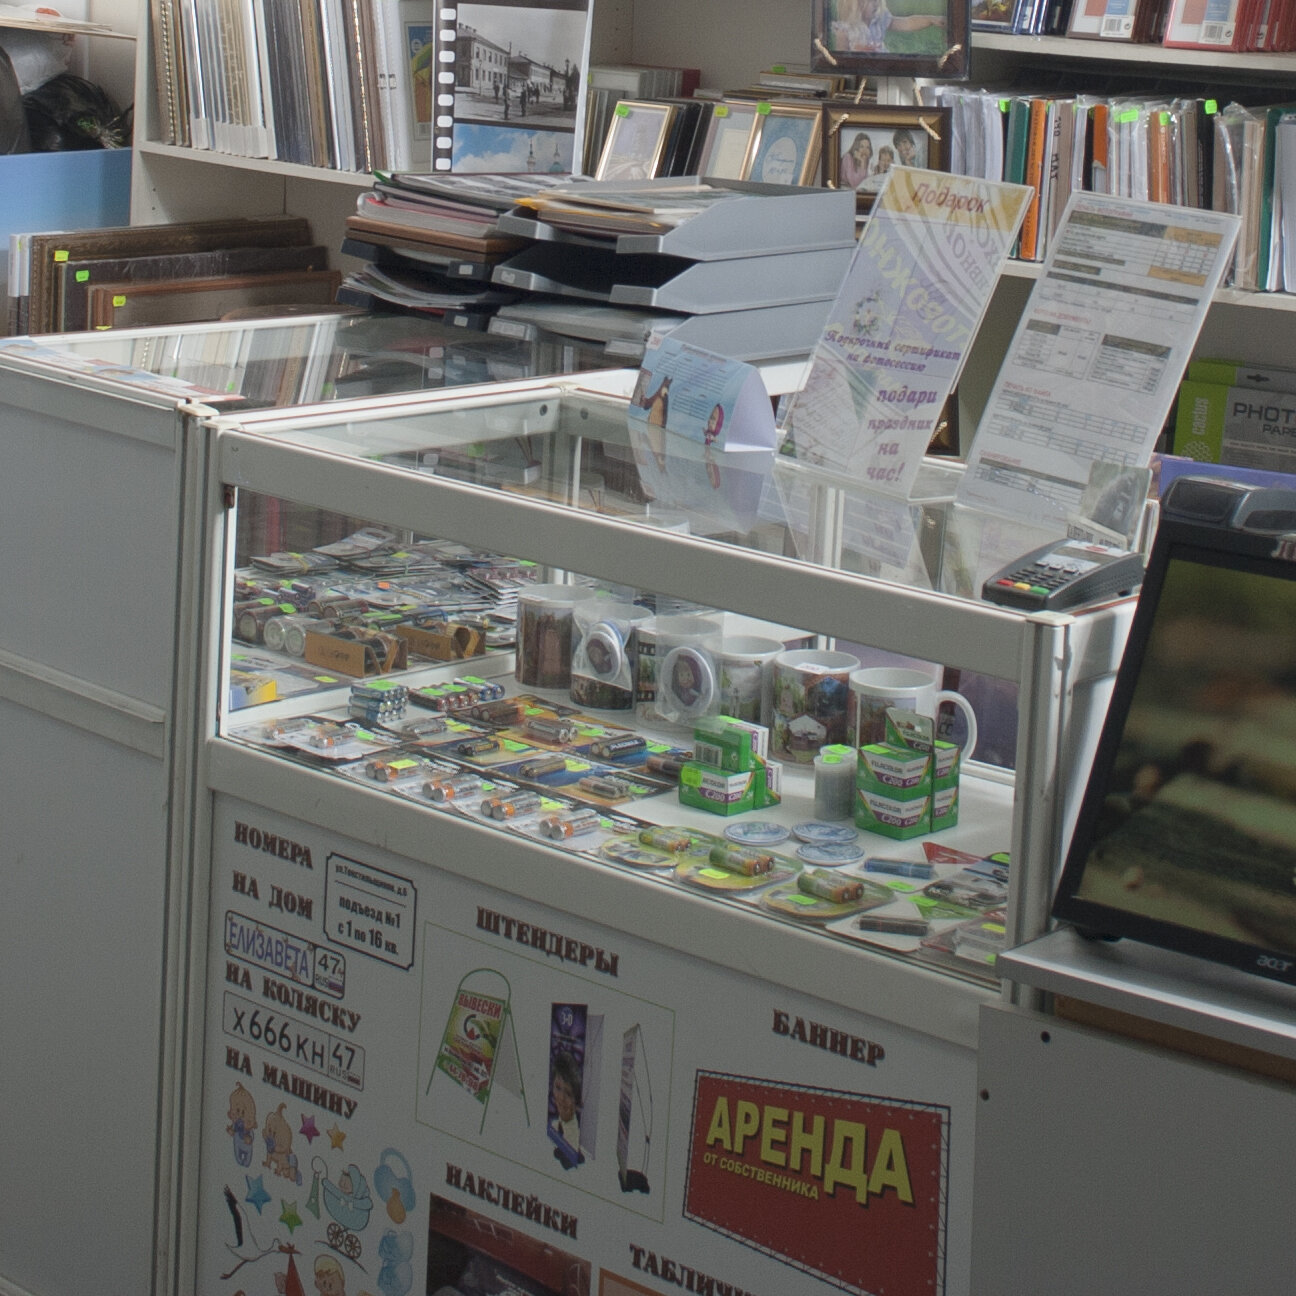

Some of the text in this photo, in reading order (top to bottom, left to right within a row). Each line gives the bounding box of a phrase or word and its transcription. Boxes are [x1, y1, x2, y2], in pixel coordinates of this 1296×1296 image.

[912, 182, 991, 214] Подарок
[824, 329, 961, 362] Подарочный сертификат
[846, 352, 927, 373] на фотосессию
[877, 385, 937, 409] подари
[868, 415, 933, 434] праздник
[1192, 397, 1209, 436] cactus
[877, 441, 900, 456] на
[866, 461, 905, 484] час!
[704, 789, 725, 802] C200
[882, 774, 903, 787] C200
[881, 813, 902, 826] C200
[234, 820, 313, 870] НОМЕРА
[232, 870, 313, 920] НА ДОМ
[339, 896, 401, 929] подъезд №1
[229, 921, 309, 979] ЕЛИЗАВЕТА
[338, 920, 399, 955] с 1 по 16 кв.
[476, 905, 619, 978] ШТЕНДЕРЫ
[318, 953, 341, 975] 47
[1256, 954, 1294, 972] acer
[225, 960, 361, 1033] НА КОЛЯСКУ
[315, 973, 329, 988] RUS
[457, 992, 502, 1020] ВЫВЕСКИ
[772, 1007, 886, 1068] БАННЕР
[329, 1064, 348, 1081] RUS
[332, 1042, 355, 1071] 47
[225, 1045, 358, 1120] НА МАШИНУ
[705, 1094, 914, 1205] АРЕНДА
[703, 1153, 820, 1201] ОТ СОБСТВЕННИКА
[446, 1162, 578, 1241] НАКЛЕЙКИ
[629, 1243, 758, 1296] ТАБЛИЧ
